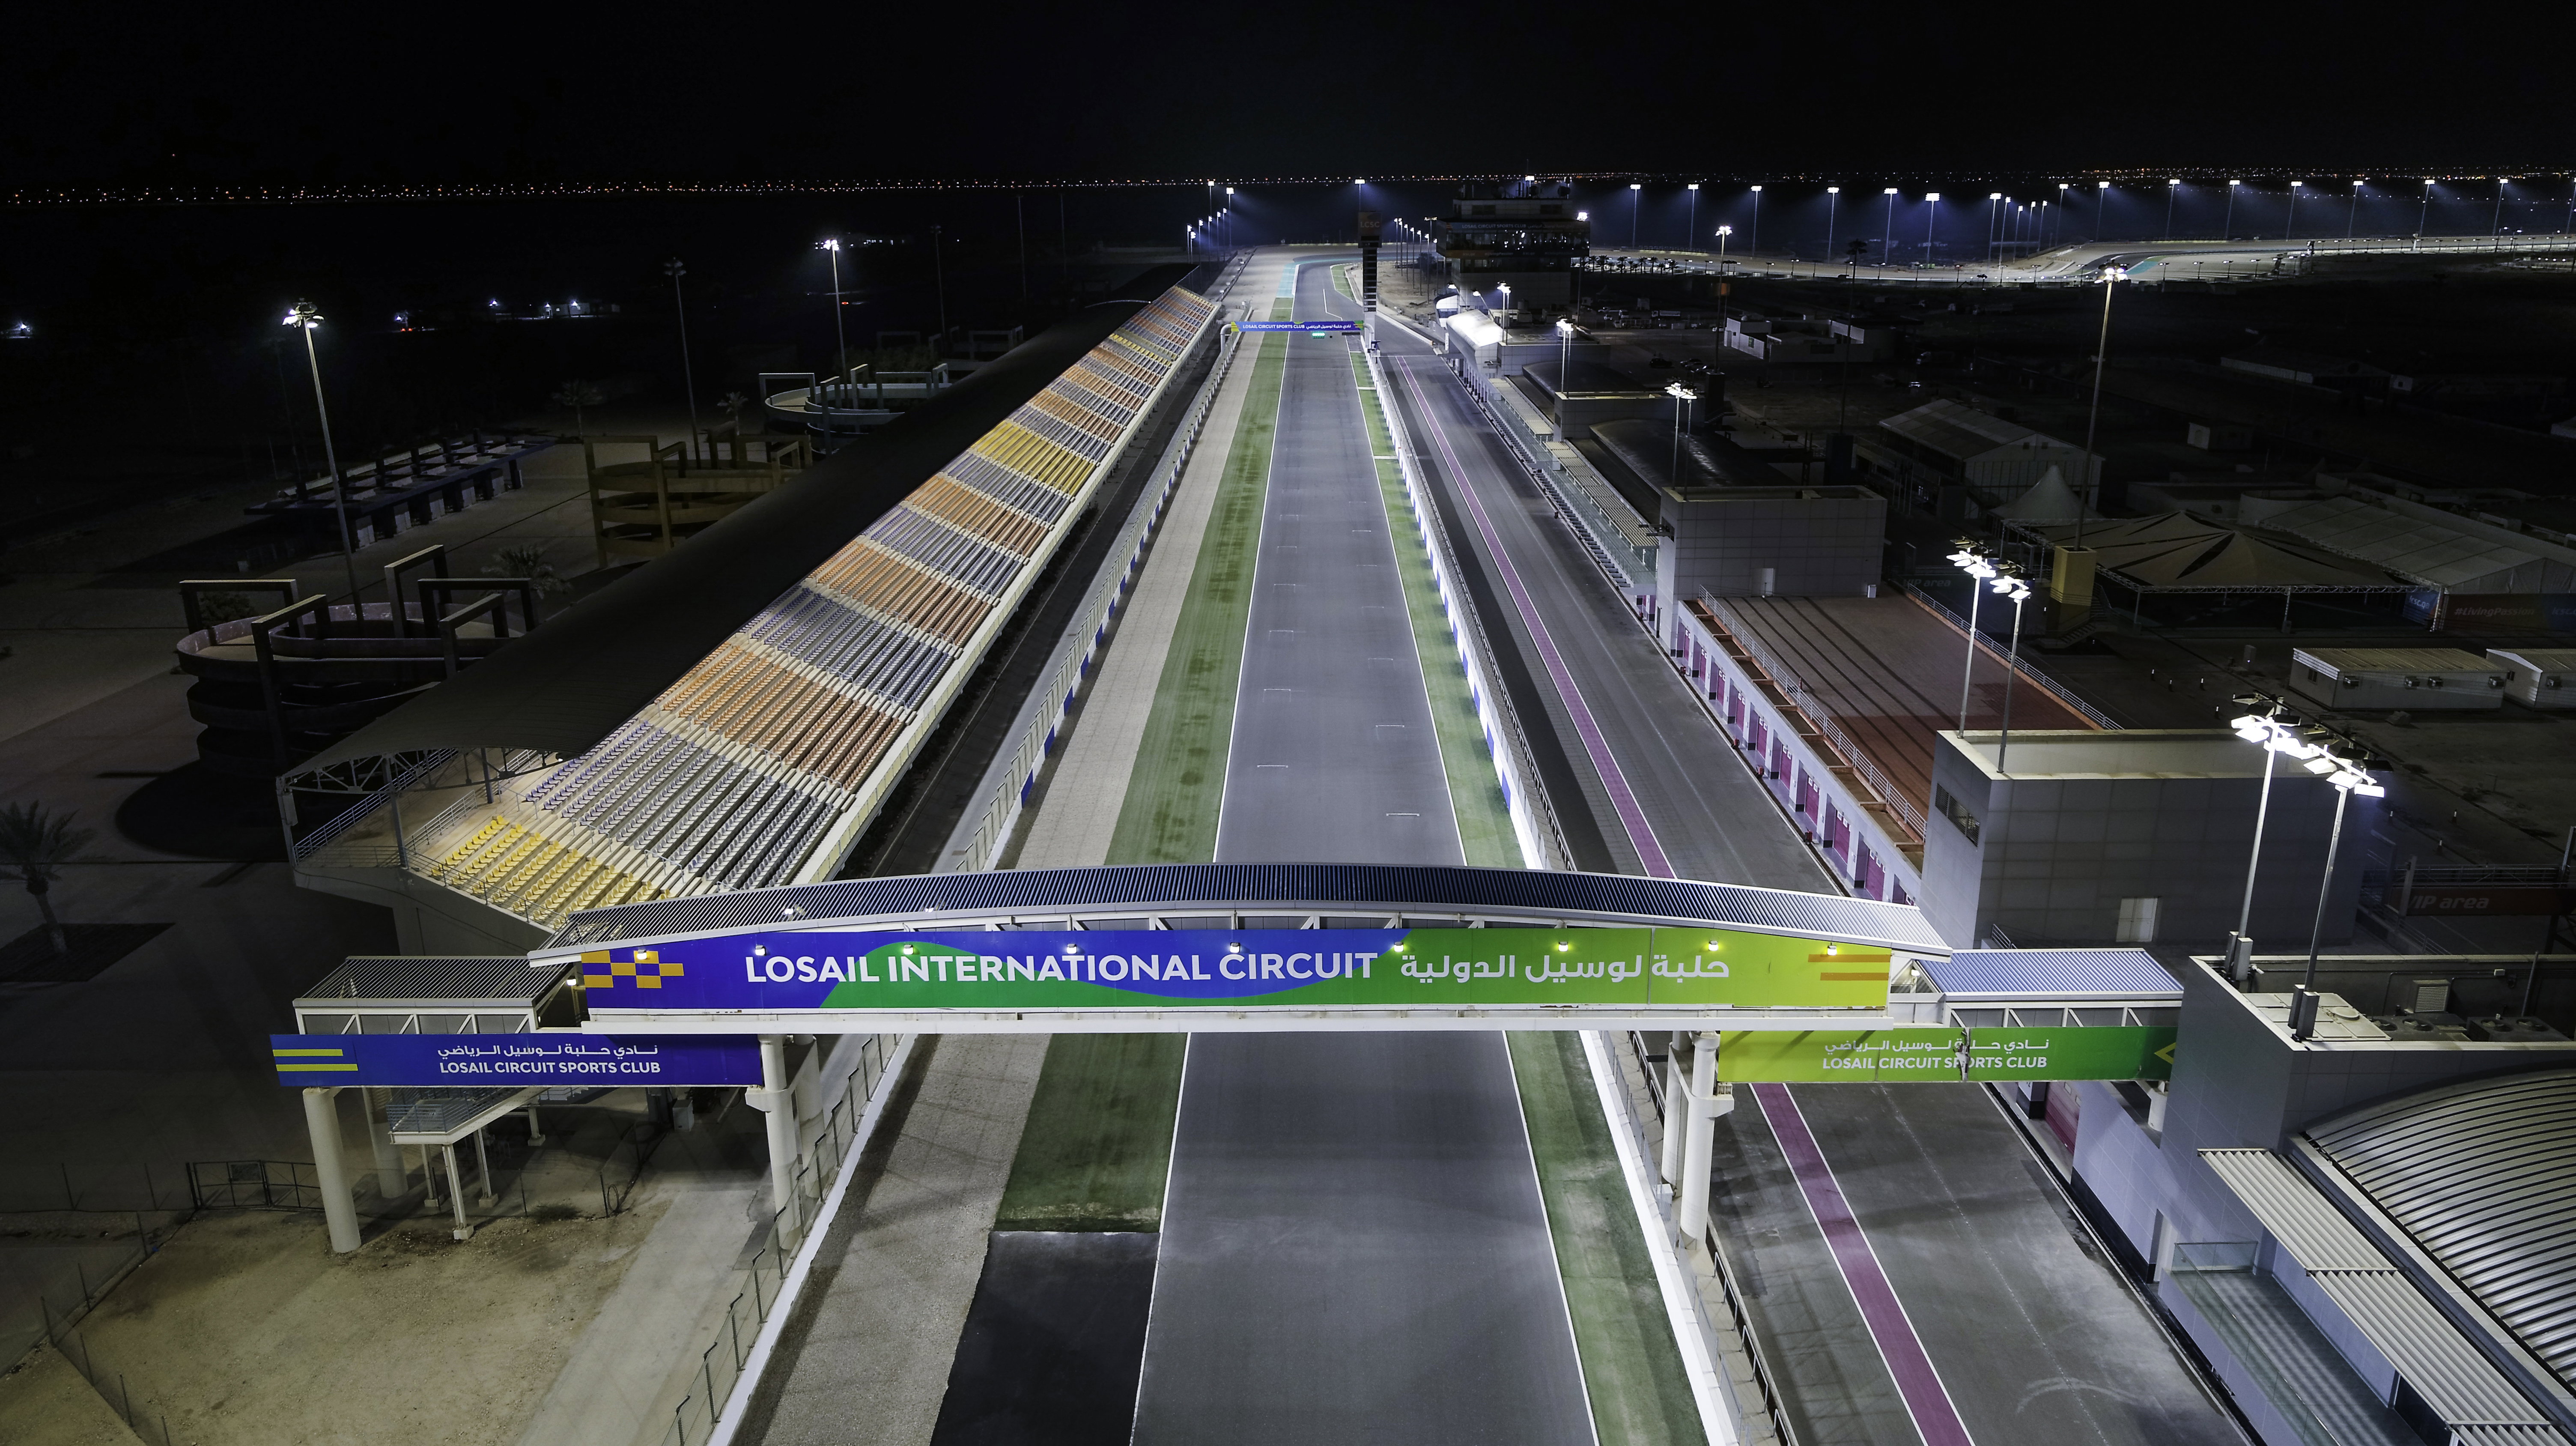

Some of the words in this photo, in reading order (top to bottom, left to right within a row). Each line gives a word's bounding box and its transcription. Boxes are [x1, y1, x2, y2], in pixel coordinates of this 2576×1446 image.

[2409, 595, 2430, 610] lcsc.qa
[2454, 607, 2535, 617] #LivingPassion
[2439, 897, 2490, 909] area
[745, 956, 880, 983] LOSAIL
[889, 954, 1211, 982] INTERNATIONAL
[1219, 953, 1378, 980] CIRCUIT
[1401, 955, 1515, 983] الدولية
[1525, 955, 1642, 983] لوسيل
[1651, 954, 1729, 983] حلبة
[1954, 1038, 2001, 1050] حلة
[440, 1062, 493, 1073] LOSAIL
[495, 1062, 556, 1073] CIRCUIT
[559, 1062, 617, 1073] SPORTS
[620, 1062, 661, 1073] CLUB
[1822, 1058, 1875, 1070] LOSAIL
[1879, 1058, 1941, 1069] CIRCUIT
[2007, 1057, 2047, 1068] CLUB
